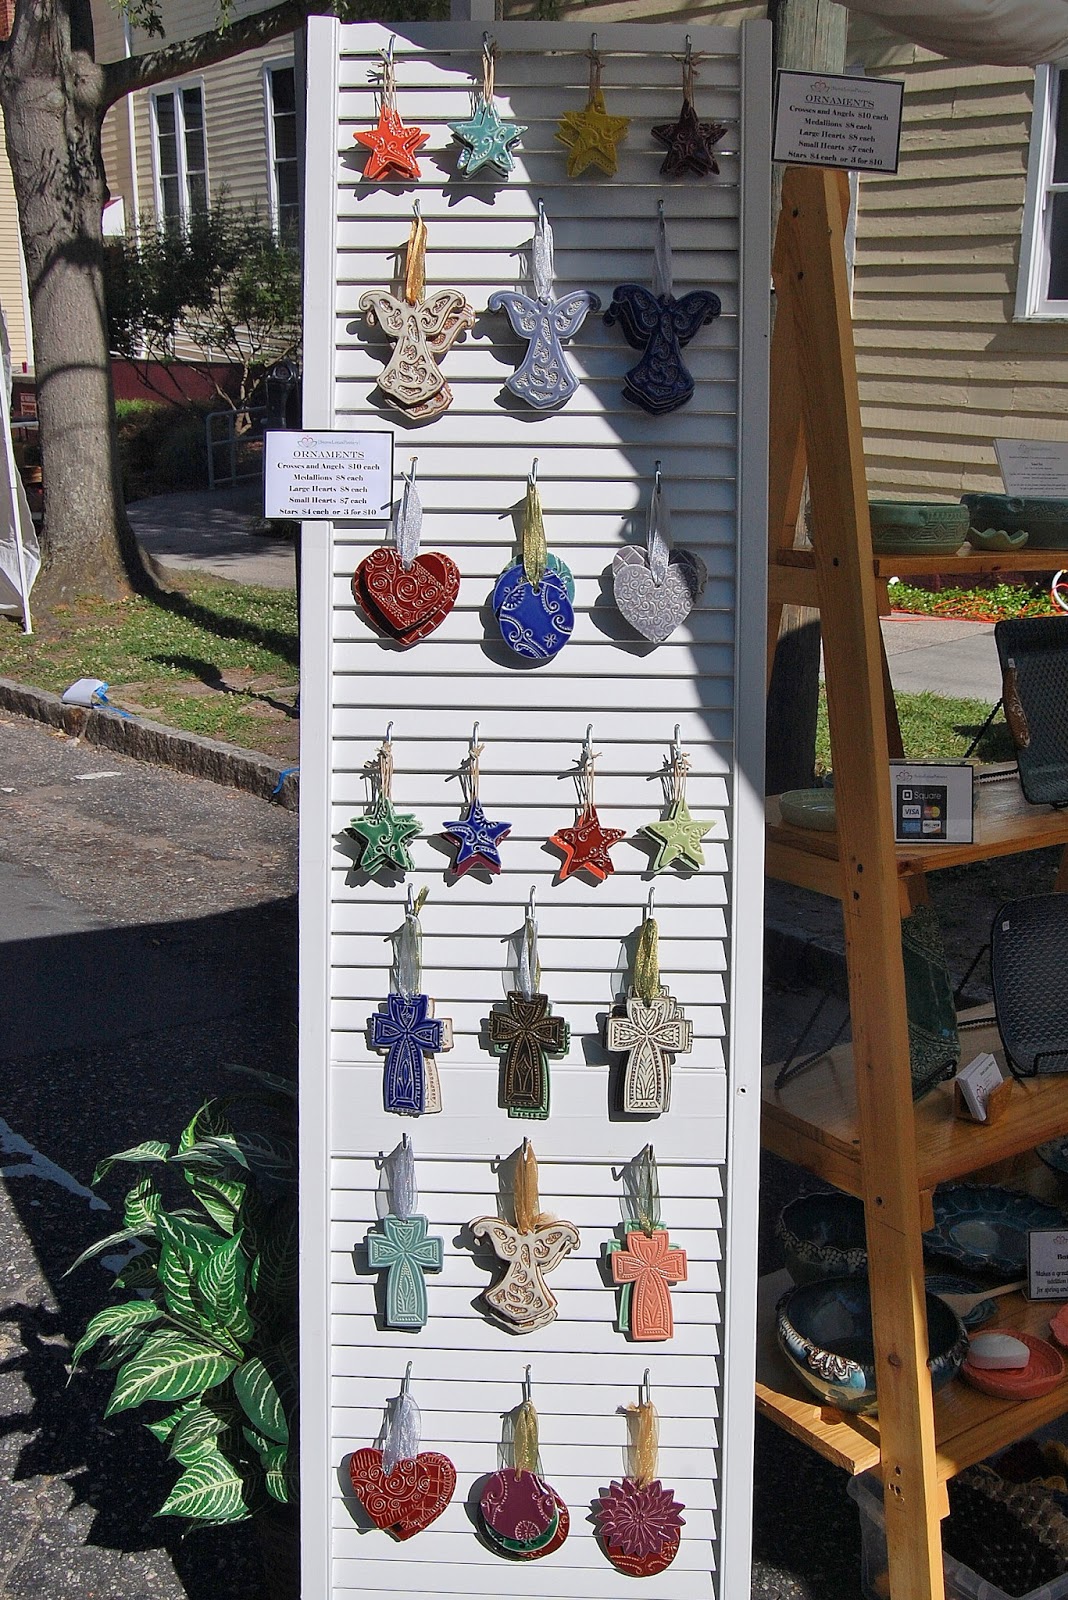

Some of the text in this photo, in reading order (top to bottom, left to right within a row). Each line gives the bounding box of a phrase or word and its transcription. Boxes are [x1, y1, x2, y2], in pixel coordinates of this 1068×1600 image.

[806, 95, 874, 108] ORNAMENTS
[790, 105, 816, 114] Crosses
[805, 118, 842, 127] Medallions
[799, 129, 819, 137] Large
[821, 131, 846, 139] Hearts
[914, 792, 941, 800] Square
